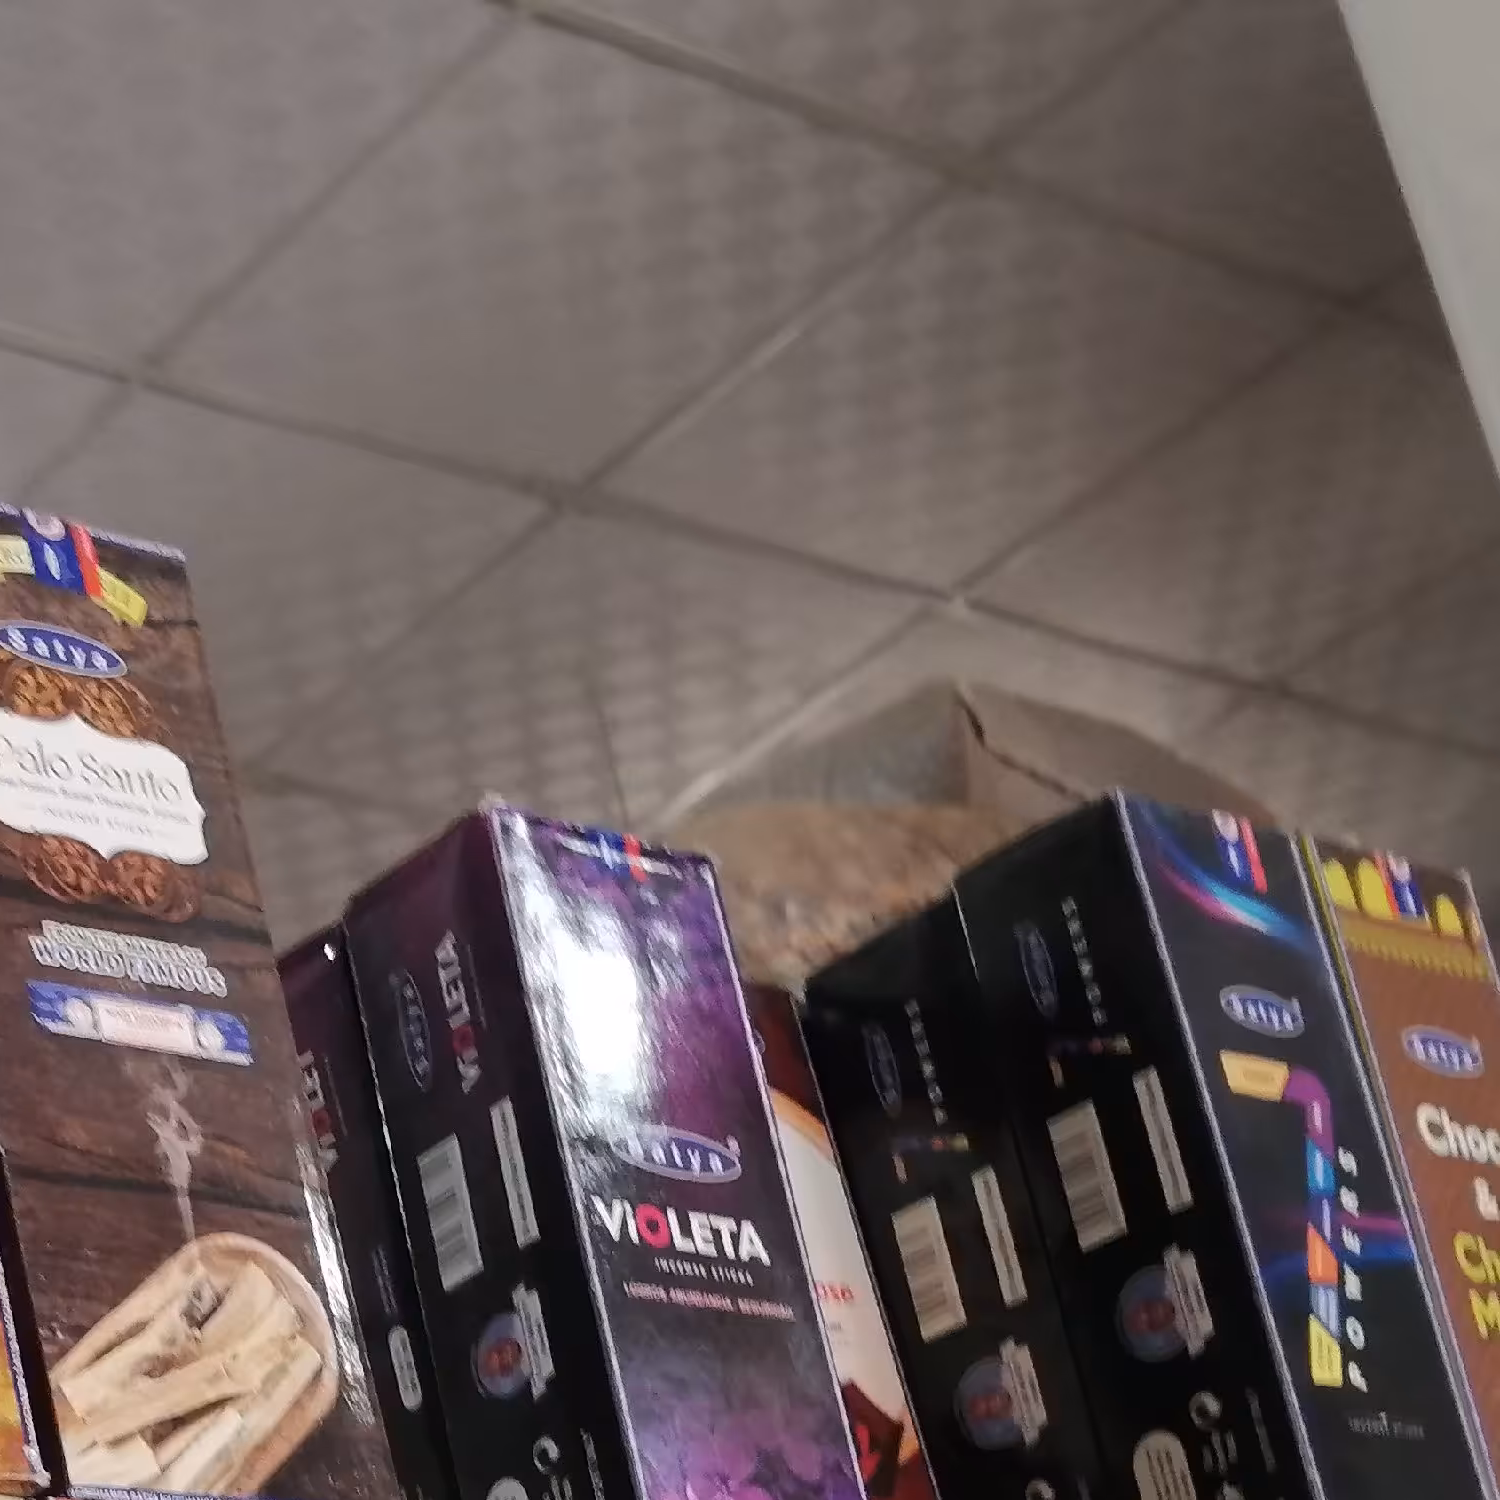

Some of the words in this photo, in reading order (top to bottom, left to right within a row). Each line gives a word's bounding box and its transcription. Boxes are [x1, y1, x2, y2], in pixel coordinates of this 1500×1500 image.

[6, 625, 108, 672] Satya
[73, 752, 182, 803] Santo
[591, 1195, 772, 1267] VIOLETA
